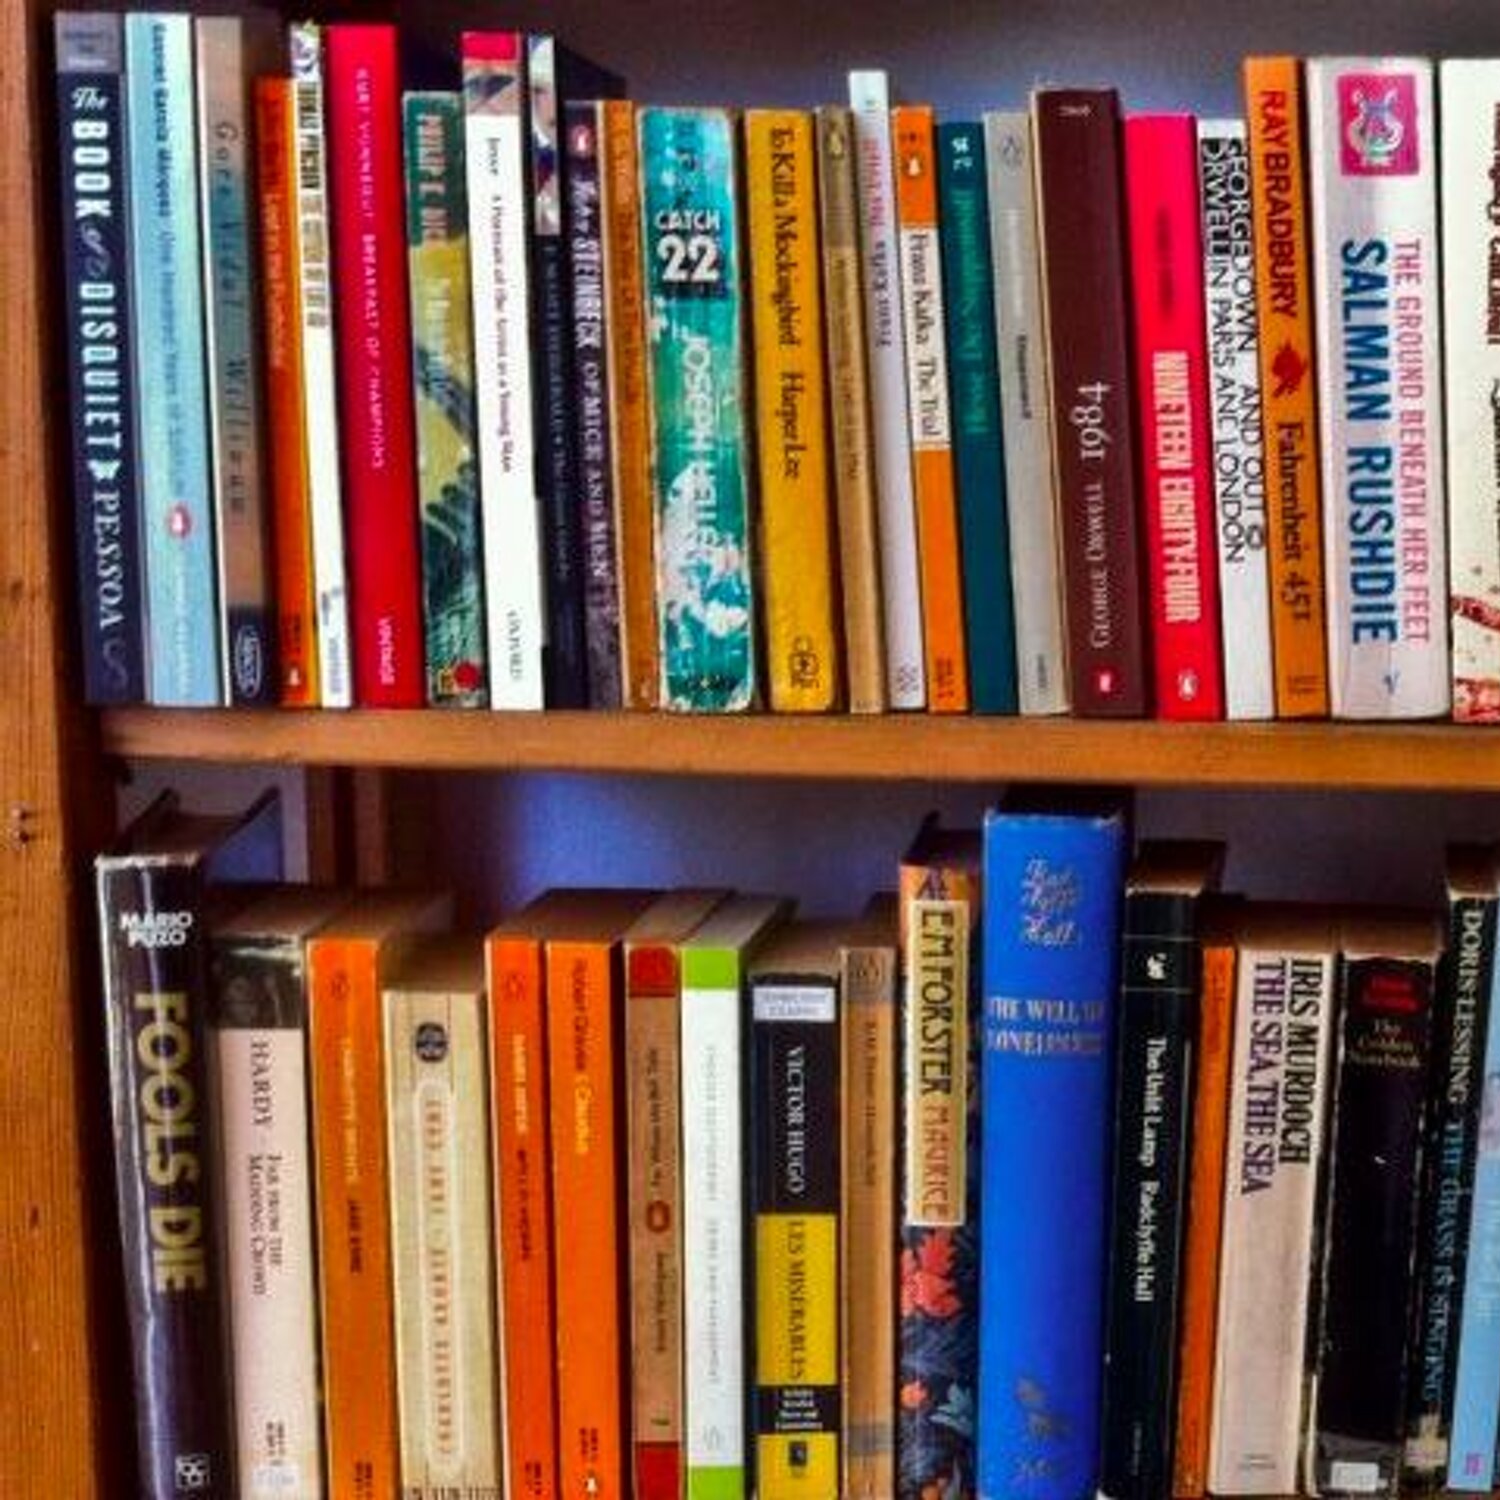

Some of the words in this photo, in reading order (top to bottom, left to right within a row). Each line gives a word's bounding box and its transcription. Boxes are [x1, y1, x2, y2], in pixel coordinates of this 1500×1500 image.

[769, 127, 793, 151] To
[1261, 91, 1287, 148] RAY
[73, 119, 111, 220] BOOK
[769, 152, 796, 192] Kill
[1200, 137, 1229, 257] ORWELL
[655, 236, 719, 283] 22
[909, 233, 933, 286] Franz
[1265, 151, 1298, 319] BRADBURY
[1394, 238, 1422, 288] THE
[361, 233, 379, 328] BREAKFAST
[572, 236, 603, 348] STEINBECK
[769, 215, 802, 347] Mockingbird
[912, 290, 936, 346] Kafka
[80, 281, 121, 449] DISQUIET
[1211, 300, 1237, 367] PARIS
[1341, 239, 1394, 421] SALMAN
[1395, 296, 1427, 400] GROUND
[582, 361, 600, 391] OF
[684, 328, 720, 450] JOSEPH
[774, 372, 806, 441] Harper
[918, 357, 938, 392] The
[1151, 351, 1193, 470] NINETEEN
[1239, 383, 1263, 444] AND
[368, 365, 387, 468] CHAMPIONS
[585, 397, 605, 461] MICE
[919, 399, 944, 437] Trial
[1073, 380, 1112, 462] 1984
[588, 469, 608, 516] AND
[784, 447, 807, 479] Lee
[1214, 437, 1245, 565] LONDON
[1244, 456, 1266, 512] OUT
[1277, 420, 1306, 563] Fahrenheit
[1399, 409, 1428, 518] BENEATH
[93, 488, 126, 629] PESSOA
[589, 522, 611, 578] MEN
[1084, 484, 1107, 563] ORWELL
[1157, 476, 1202, 625] EIGHTY-FOUR
[1350, 446, 1399, 645] RUSHDIE
[1402, 527, 1430, 574] HER
[1090, 570, 1109, 649] GEORGE
[1404, 583, 1432, 645] FEET
[119, 911, 193, 930] MARIO
[127, 929, 187, 949] PUZO
[1456, 909, 1487, 993] DORIS
[1252, 957, 1287, 1015] THE
[1288, 957, 1326, 1016] IRIS
[920, 963, 953, 1096] FORSTER
[1146, 1035, 1169, 1068] The
[1448, 999, 1476, 1105] LESSING
[134, 992, 198, 1187] FOOLS
[251, 1041, 277, 1128] HARDY
[786, 1045, 807, 1126] VICTOR
[1143, 1072, 1167, 1110] Unlit
[1243, 1080, 1280, 1135] THE
[1277, 1022, 1321, 1165] MURDOCH
[784, 1131, 807, 1197] HUGO
[919, 1102, 951, 1221] MAURICE
[1137, 1114, 1162, 1167] Lamp
[1239, 1139, 1277, 1196] SEA
[249, 1154, 270, 1232] MADDING
[1135, 1179, 1163, 1265] Radclyffe
[1434, 1178, 1463, 1258] GRASS
[149, 1206, 206, 1296] DIE
[251, 1238, 268, 1298] CROWD
[788, 1220, 807, 1254] LES
[1133, 1269, 1156, 1303] Hall
[1426, 1294, 1452, 1402] SINGING
